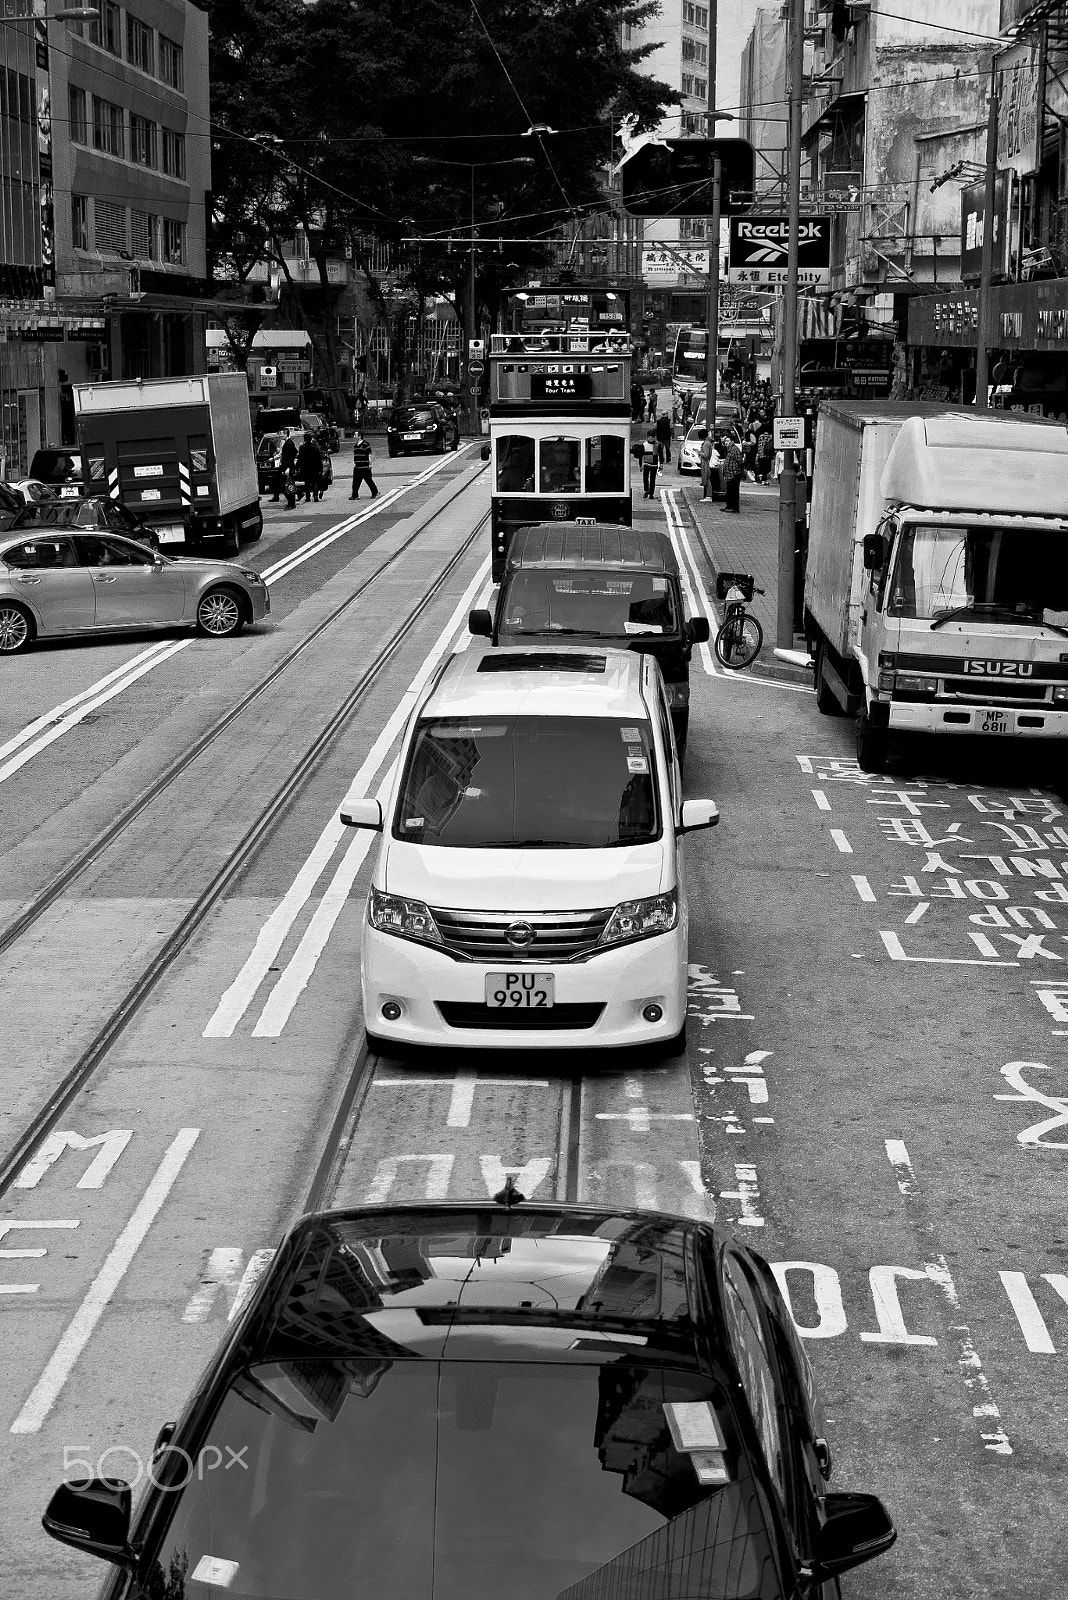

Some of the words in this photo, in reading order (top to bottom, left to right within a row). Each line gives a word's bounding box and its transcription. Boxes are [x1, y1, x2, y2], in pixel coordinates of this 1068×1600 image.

[738, 222, 822, 237] Reebok
[768, 272, 822, 283] Etenity
[801, 360, 838, 373] Clar
[963, 660, 1033, 677] ISUZU
[986, 711, 1004, 722] MP
[981, 721, 1007, 733] 6811
[967, 932, 1068, 959] XI
[506, 974, 535, 990] PU
[494, 990, 548, 1006] 9912
